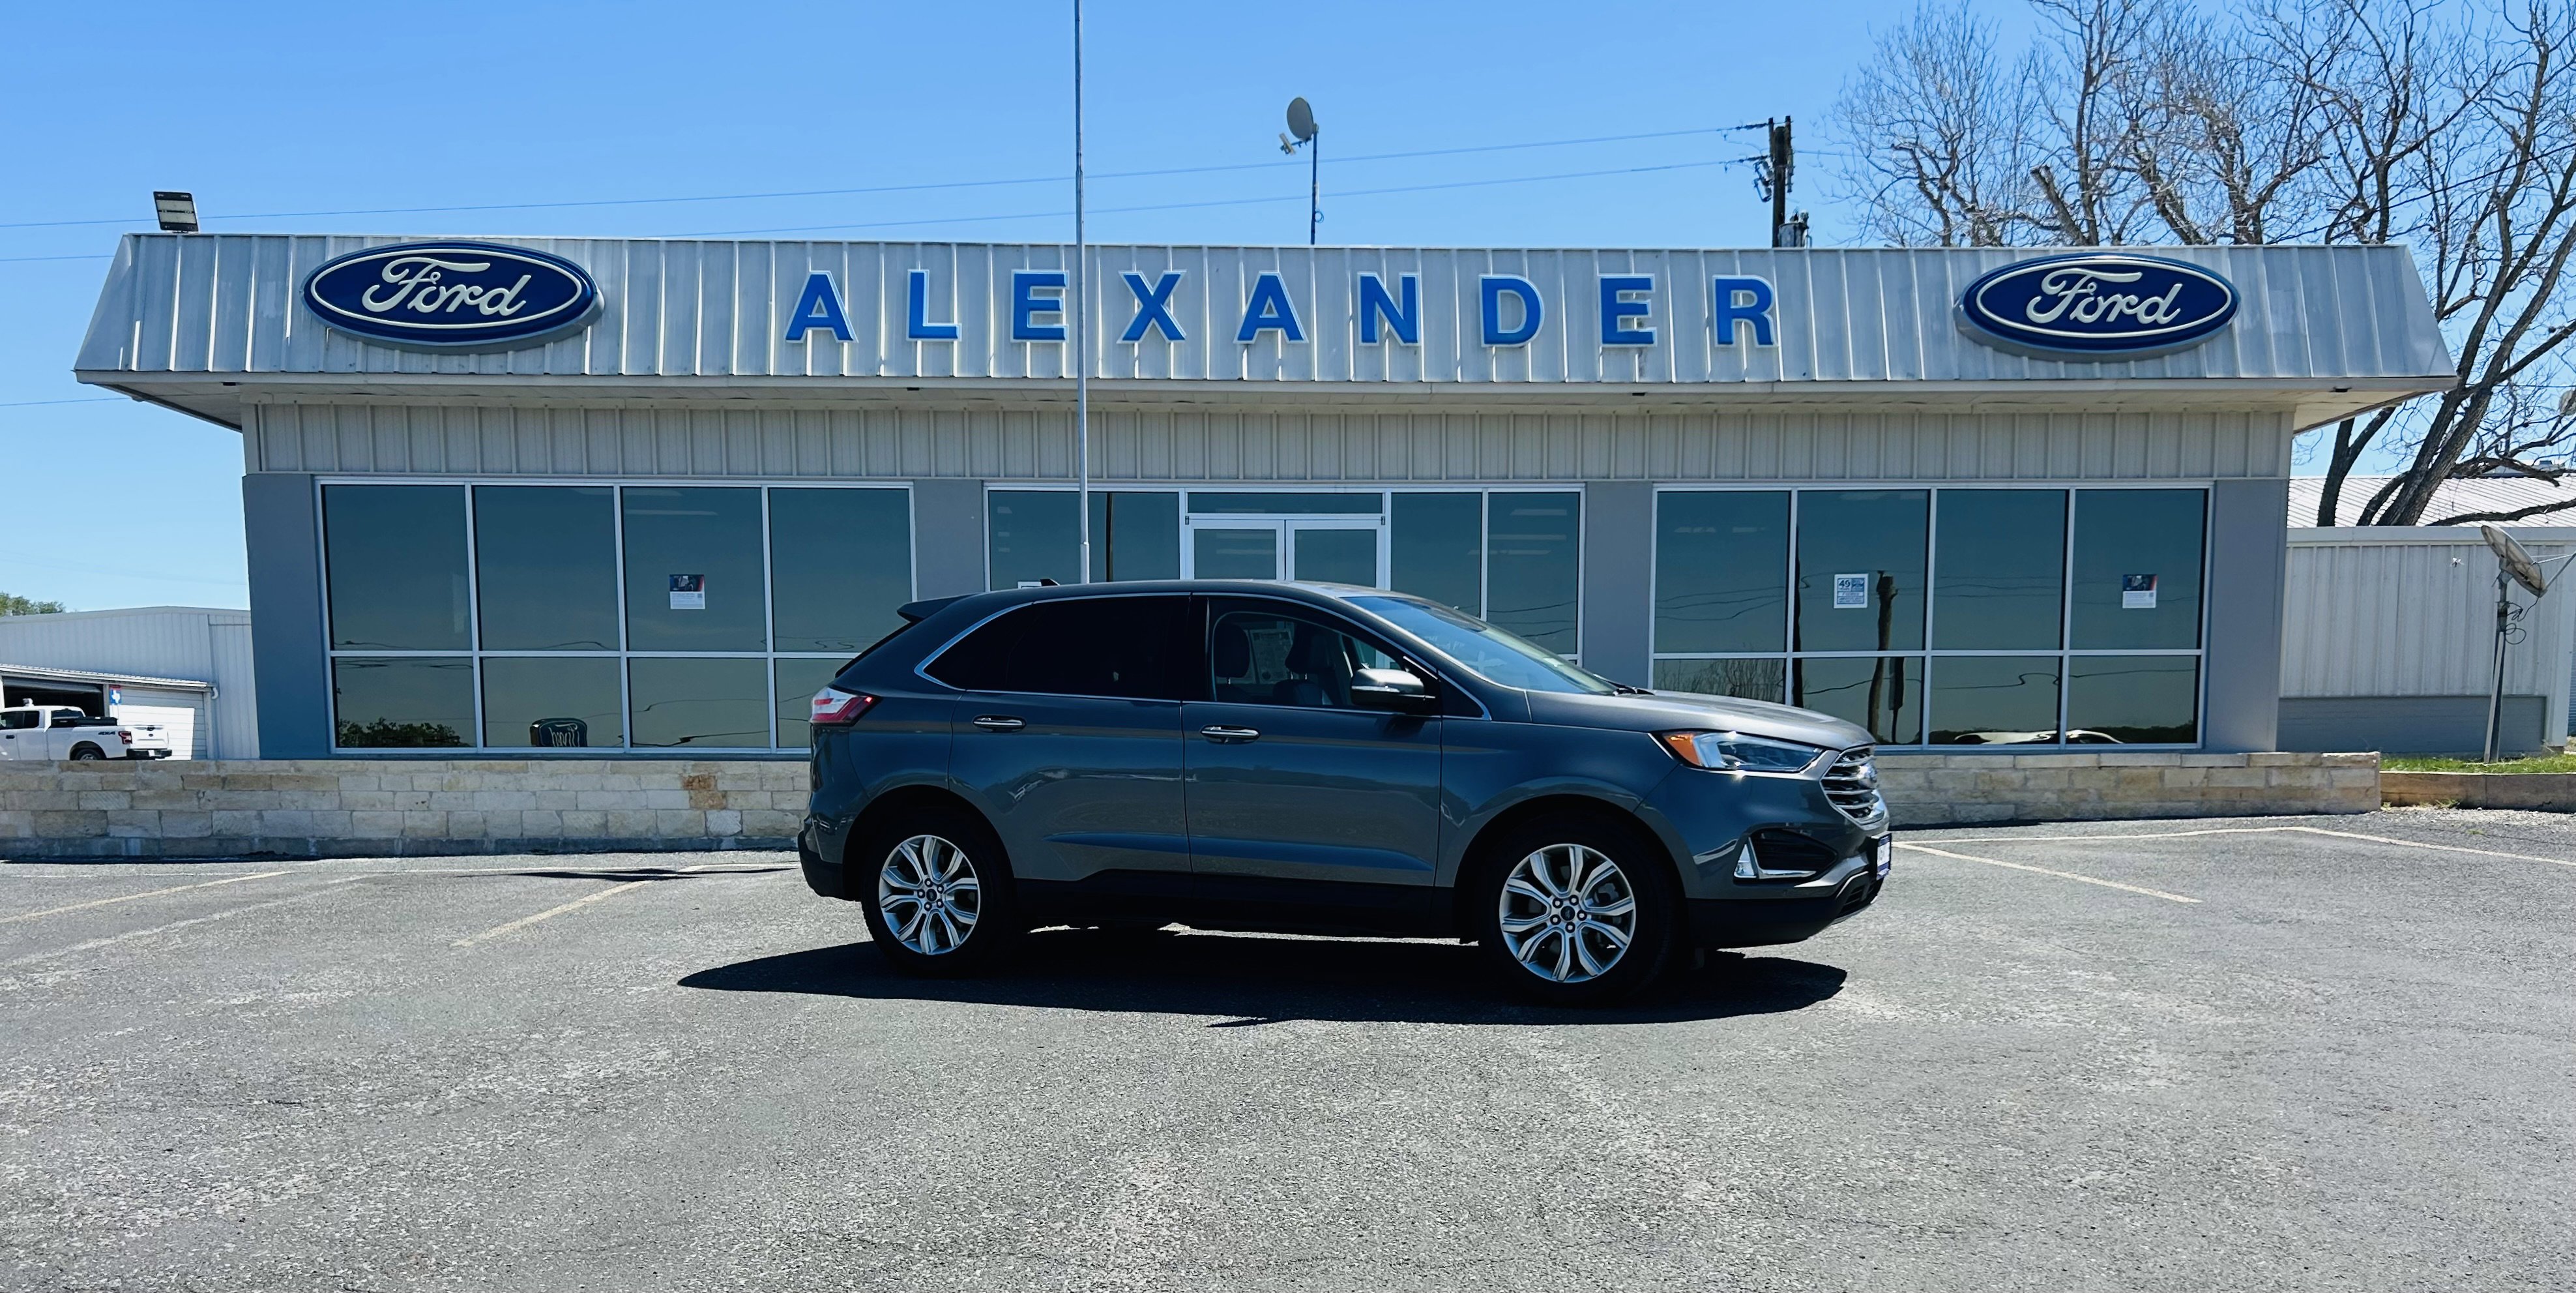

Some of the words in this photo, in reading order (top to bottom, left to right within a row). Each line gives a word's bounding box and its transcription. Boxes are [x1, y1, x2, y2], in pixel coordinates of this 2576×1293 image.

[362, 257, 531, 316] Ford
[784, 269, 1778, 348] ALEXANDER
[2026, 268, 2183, 324] Ford
